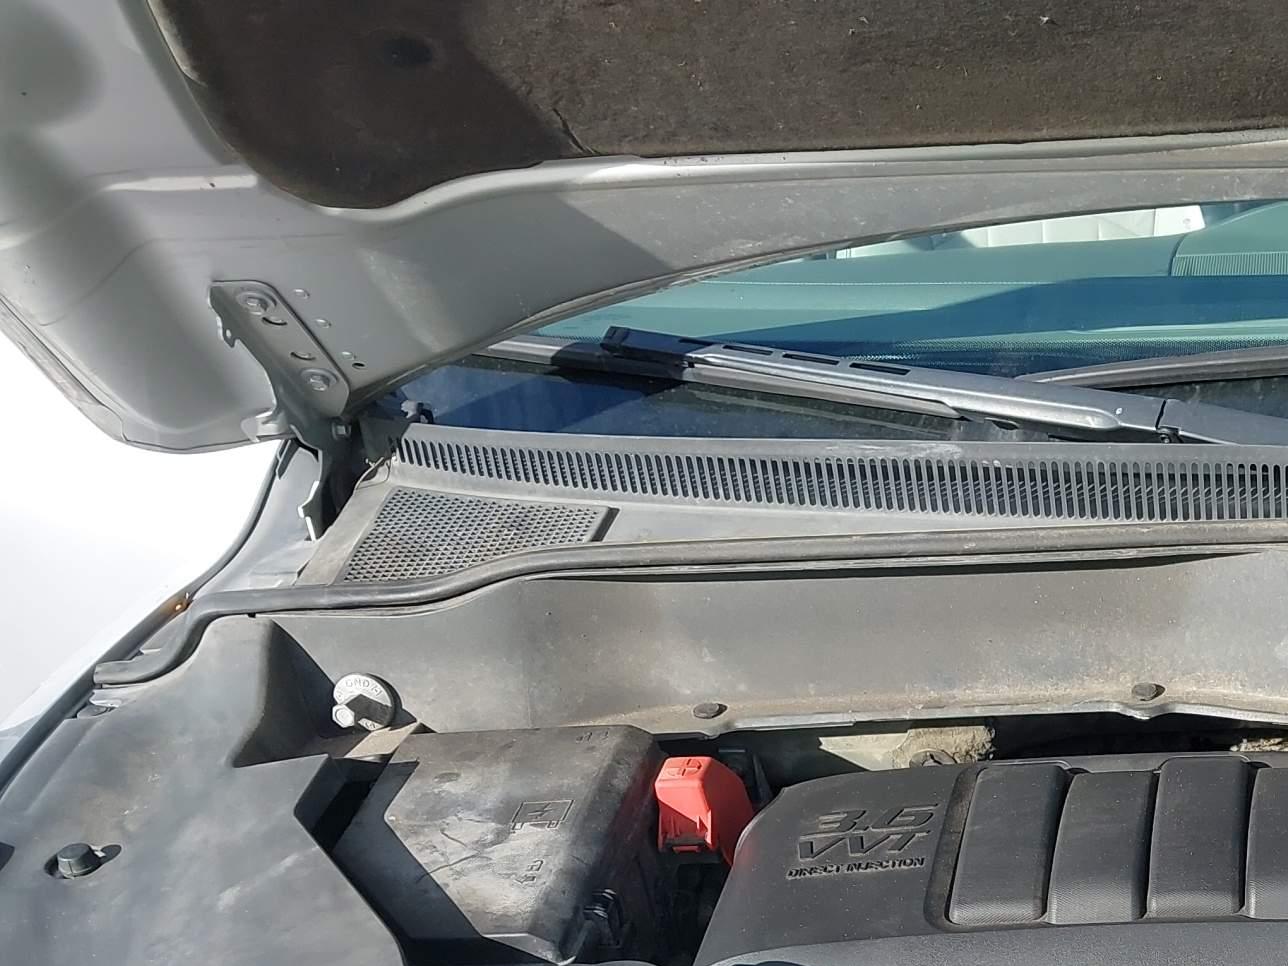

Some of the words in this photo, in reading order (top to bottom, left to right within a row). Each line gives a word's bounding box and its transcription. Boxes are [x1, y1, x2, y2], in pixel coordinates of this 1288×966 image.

[806, 802, 939, 836] 3.6
[798, 830, 931, 861] VVT
[786, 862, 843, 880] DIRECT
[844, 856, 927, 873] INJECTION
